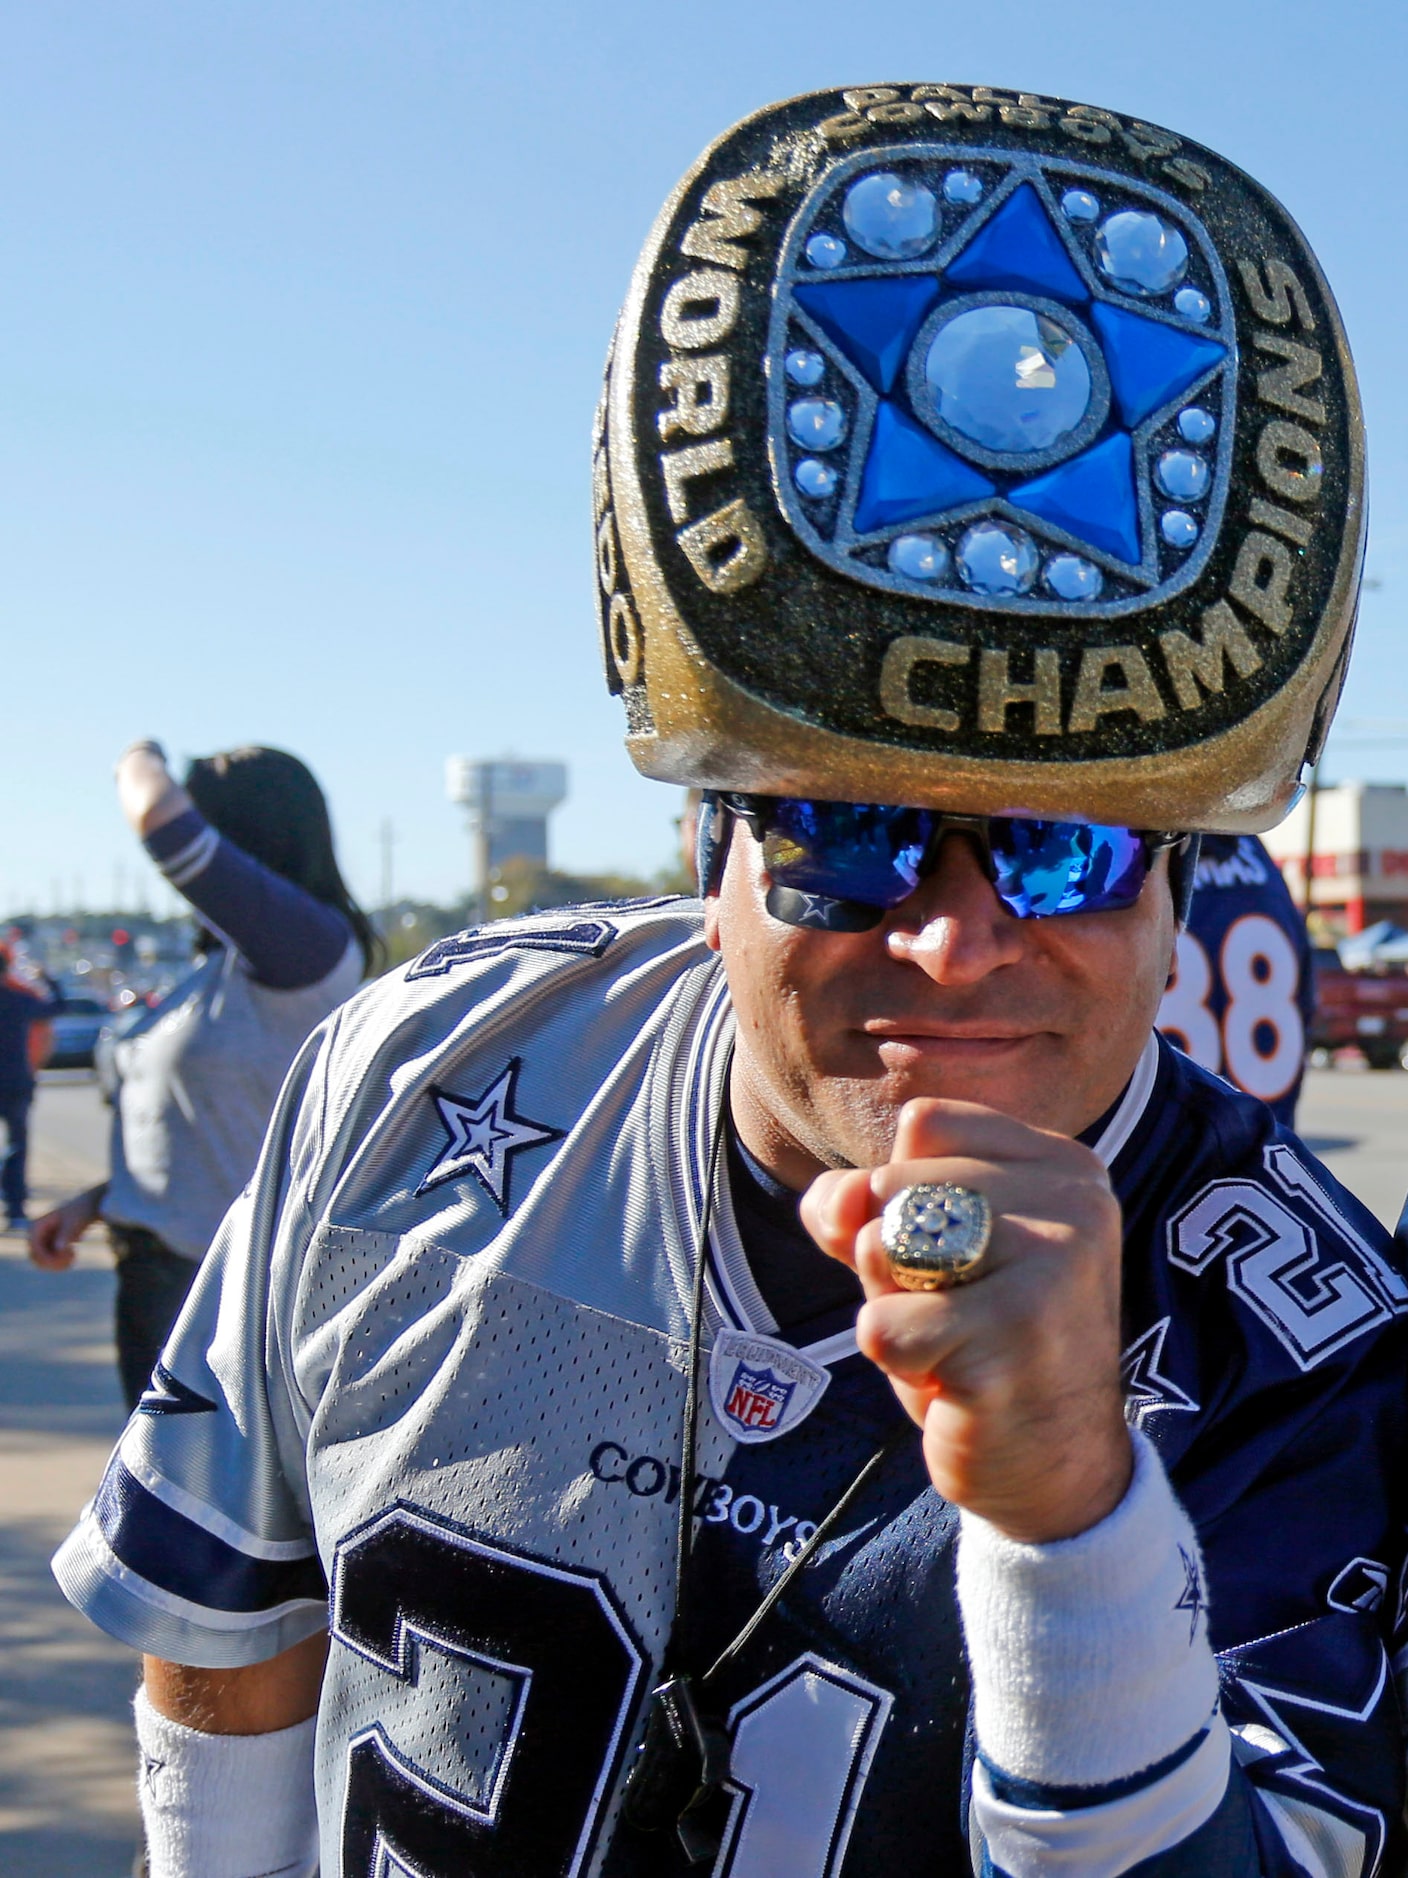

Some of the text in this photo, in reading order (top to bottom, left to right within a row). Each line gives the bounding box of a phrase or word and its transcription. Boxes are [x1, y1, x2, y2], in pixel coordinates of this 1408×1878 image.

[660, 173, 785, 593] WORLD
[880, 259, 1327, 736] CHAMPIONS
[588, 1440, 823, 1563] COWBOYS
[726, 1385, 778, 1427] NFL
[326, 1496, 896, 1878] 21
